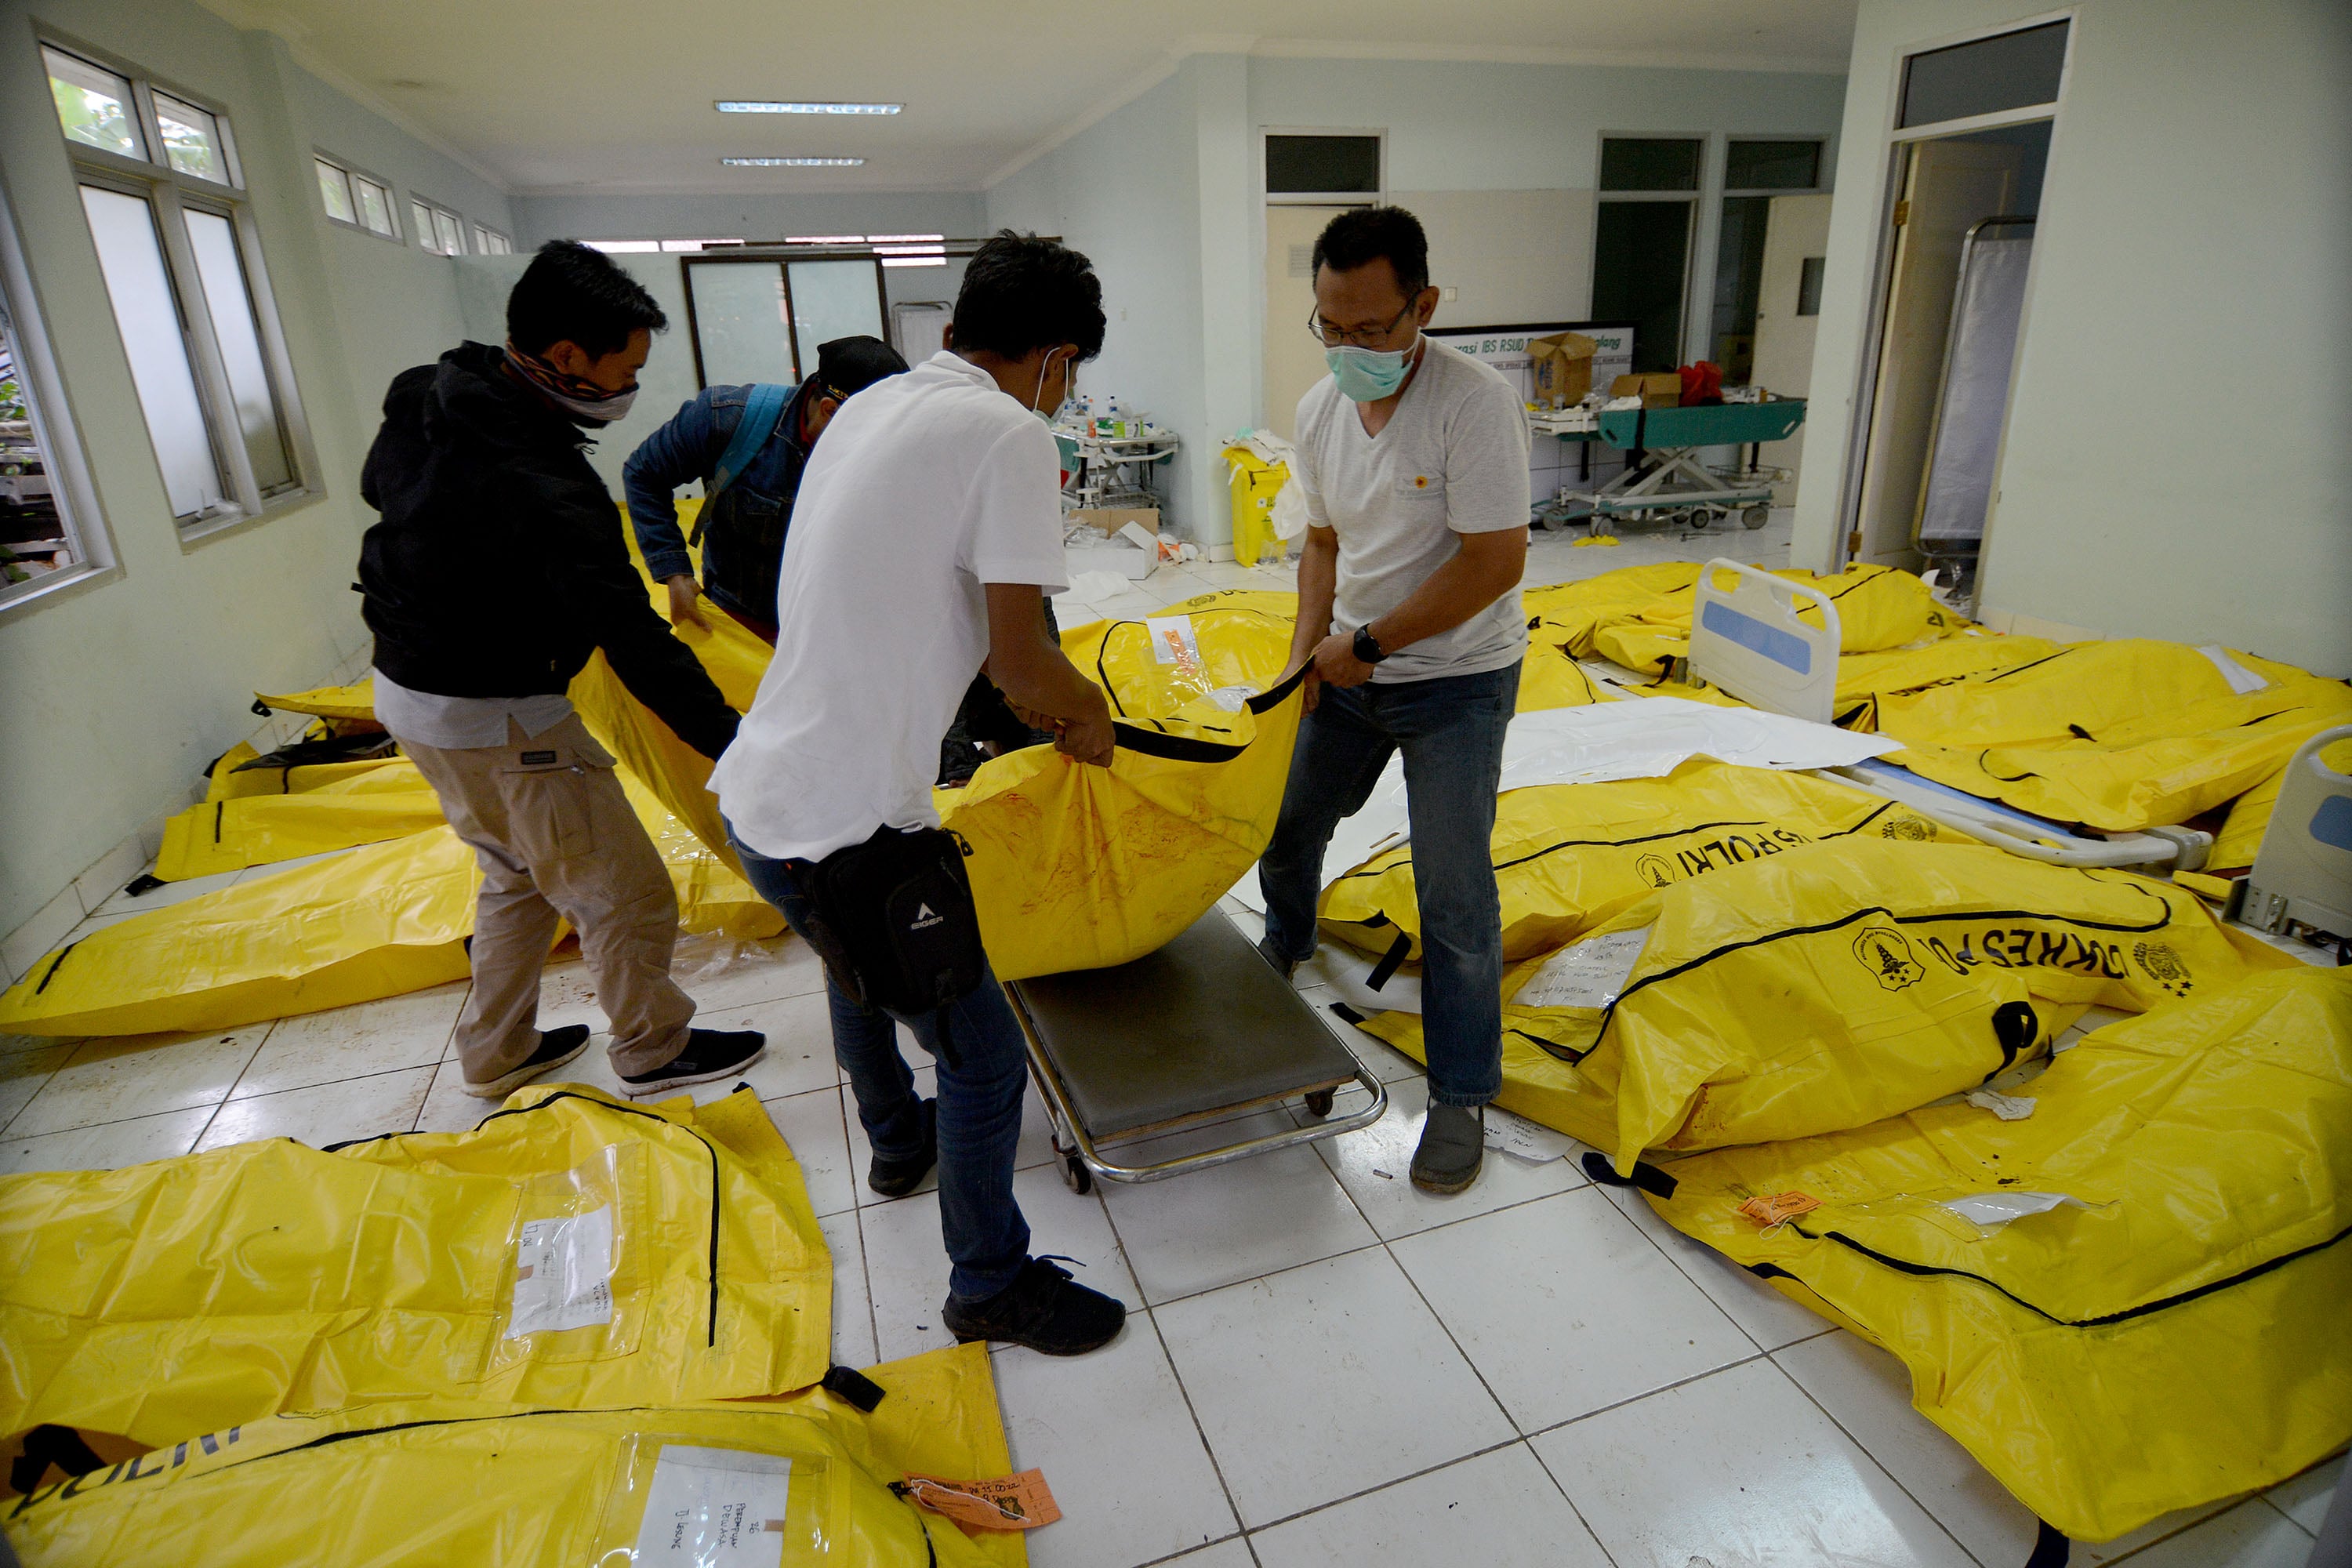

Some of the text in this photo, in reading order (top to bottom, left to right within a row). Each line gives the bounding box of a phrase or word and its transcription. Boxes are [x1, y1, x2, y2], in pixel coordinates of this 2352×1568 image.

[1482, 338, 1497, 353] IBS
[1499, 338, 1525, 353] RSUD
[910, 916, 944, 930] EIGER
